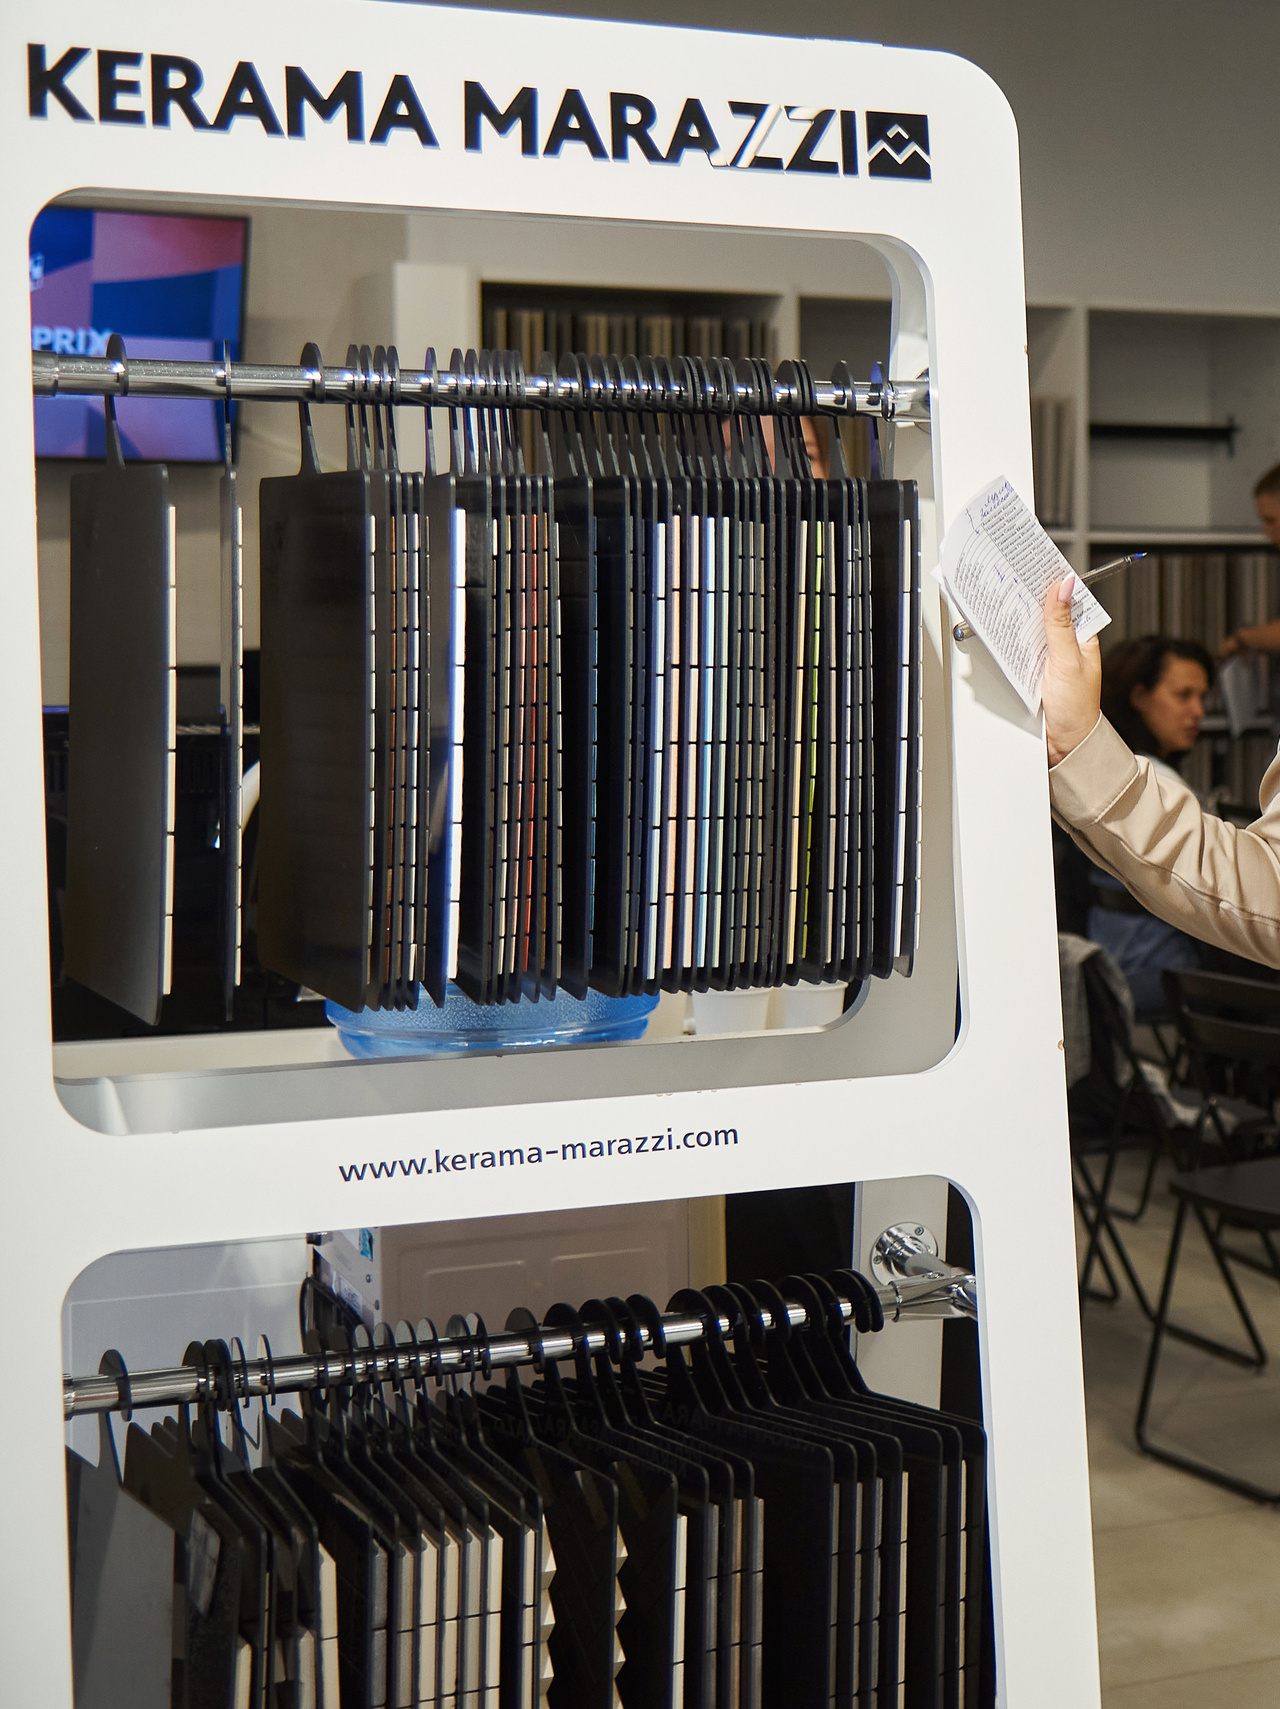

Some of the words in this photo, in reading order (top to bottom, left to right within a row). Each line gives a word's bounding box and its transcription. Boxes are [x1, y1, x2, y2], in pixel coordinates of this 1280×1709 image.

[27, 43, 439, 148] KERAMA
[464, 80, 860, 175] MARAZZI
[338, 1126, 740, 1182] www.kerama-marazzi.com
